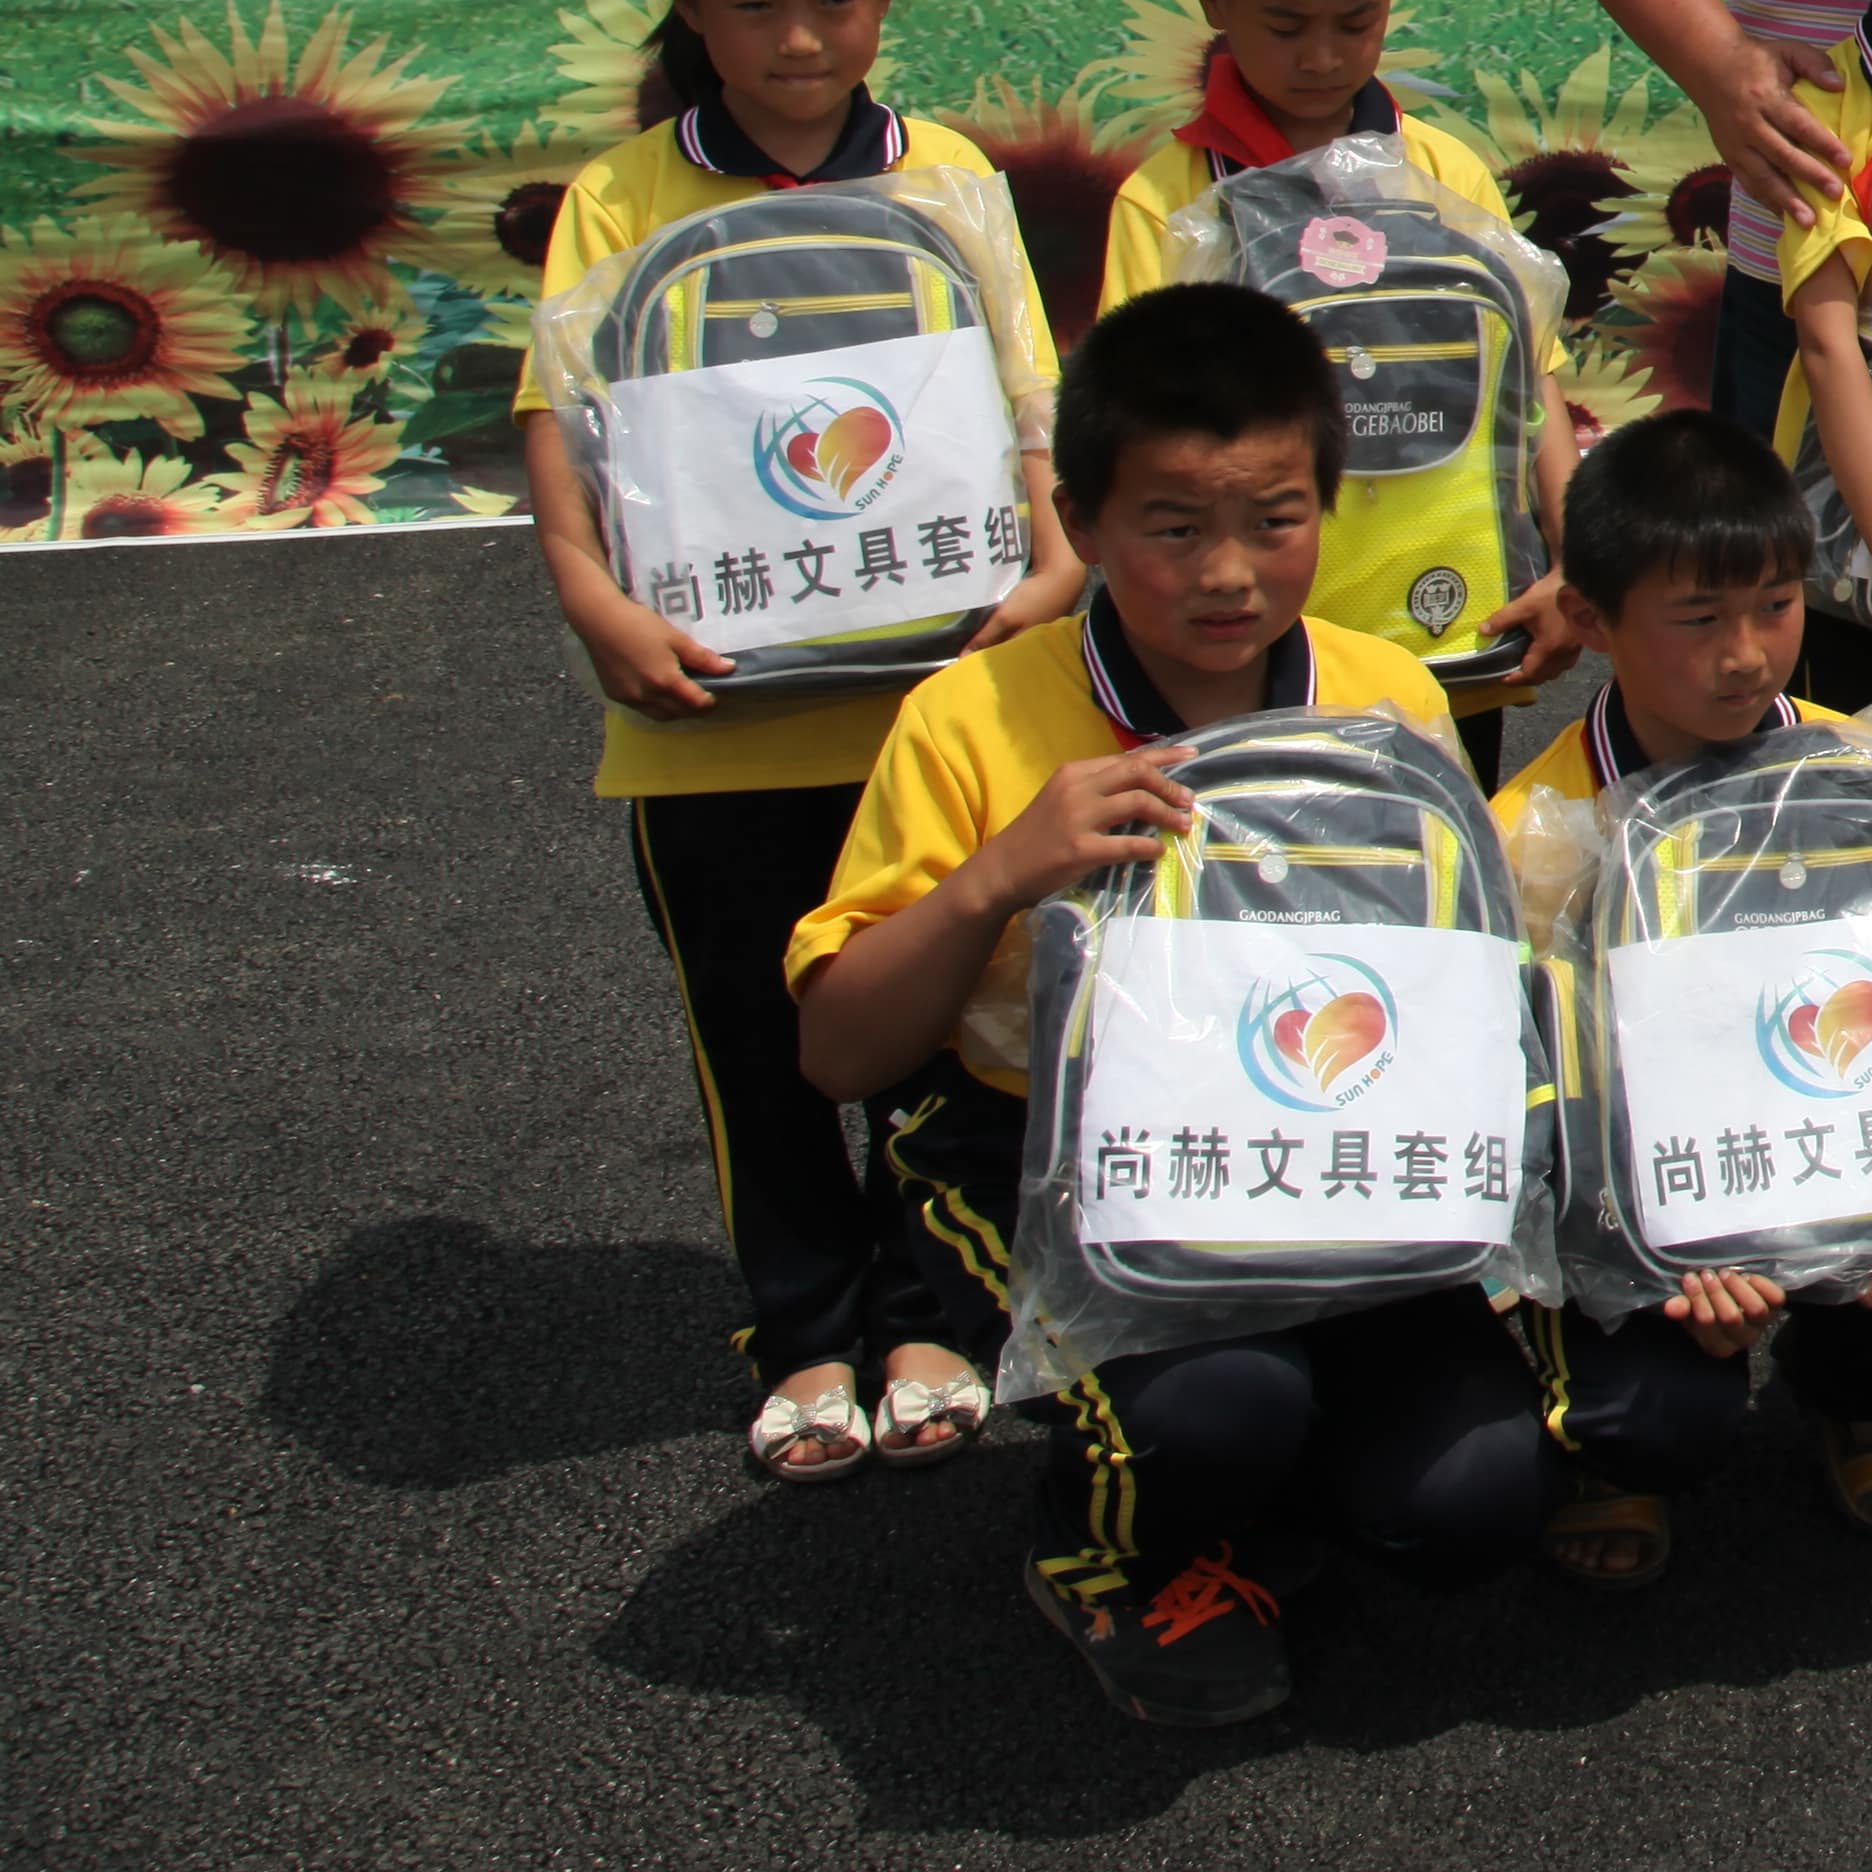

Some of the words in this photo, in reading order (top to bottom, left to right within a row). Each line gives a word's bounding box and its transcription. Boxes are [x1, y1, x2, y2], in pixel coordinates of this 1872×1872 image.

[1346, 412, 1444, 437] GEBAOBEI
[648, 505, 1024, 623] 尚赫文具套组
[1096, 1126, 1511, 1203] 尚赫文具套组
